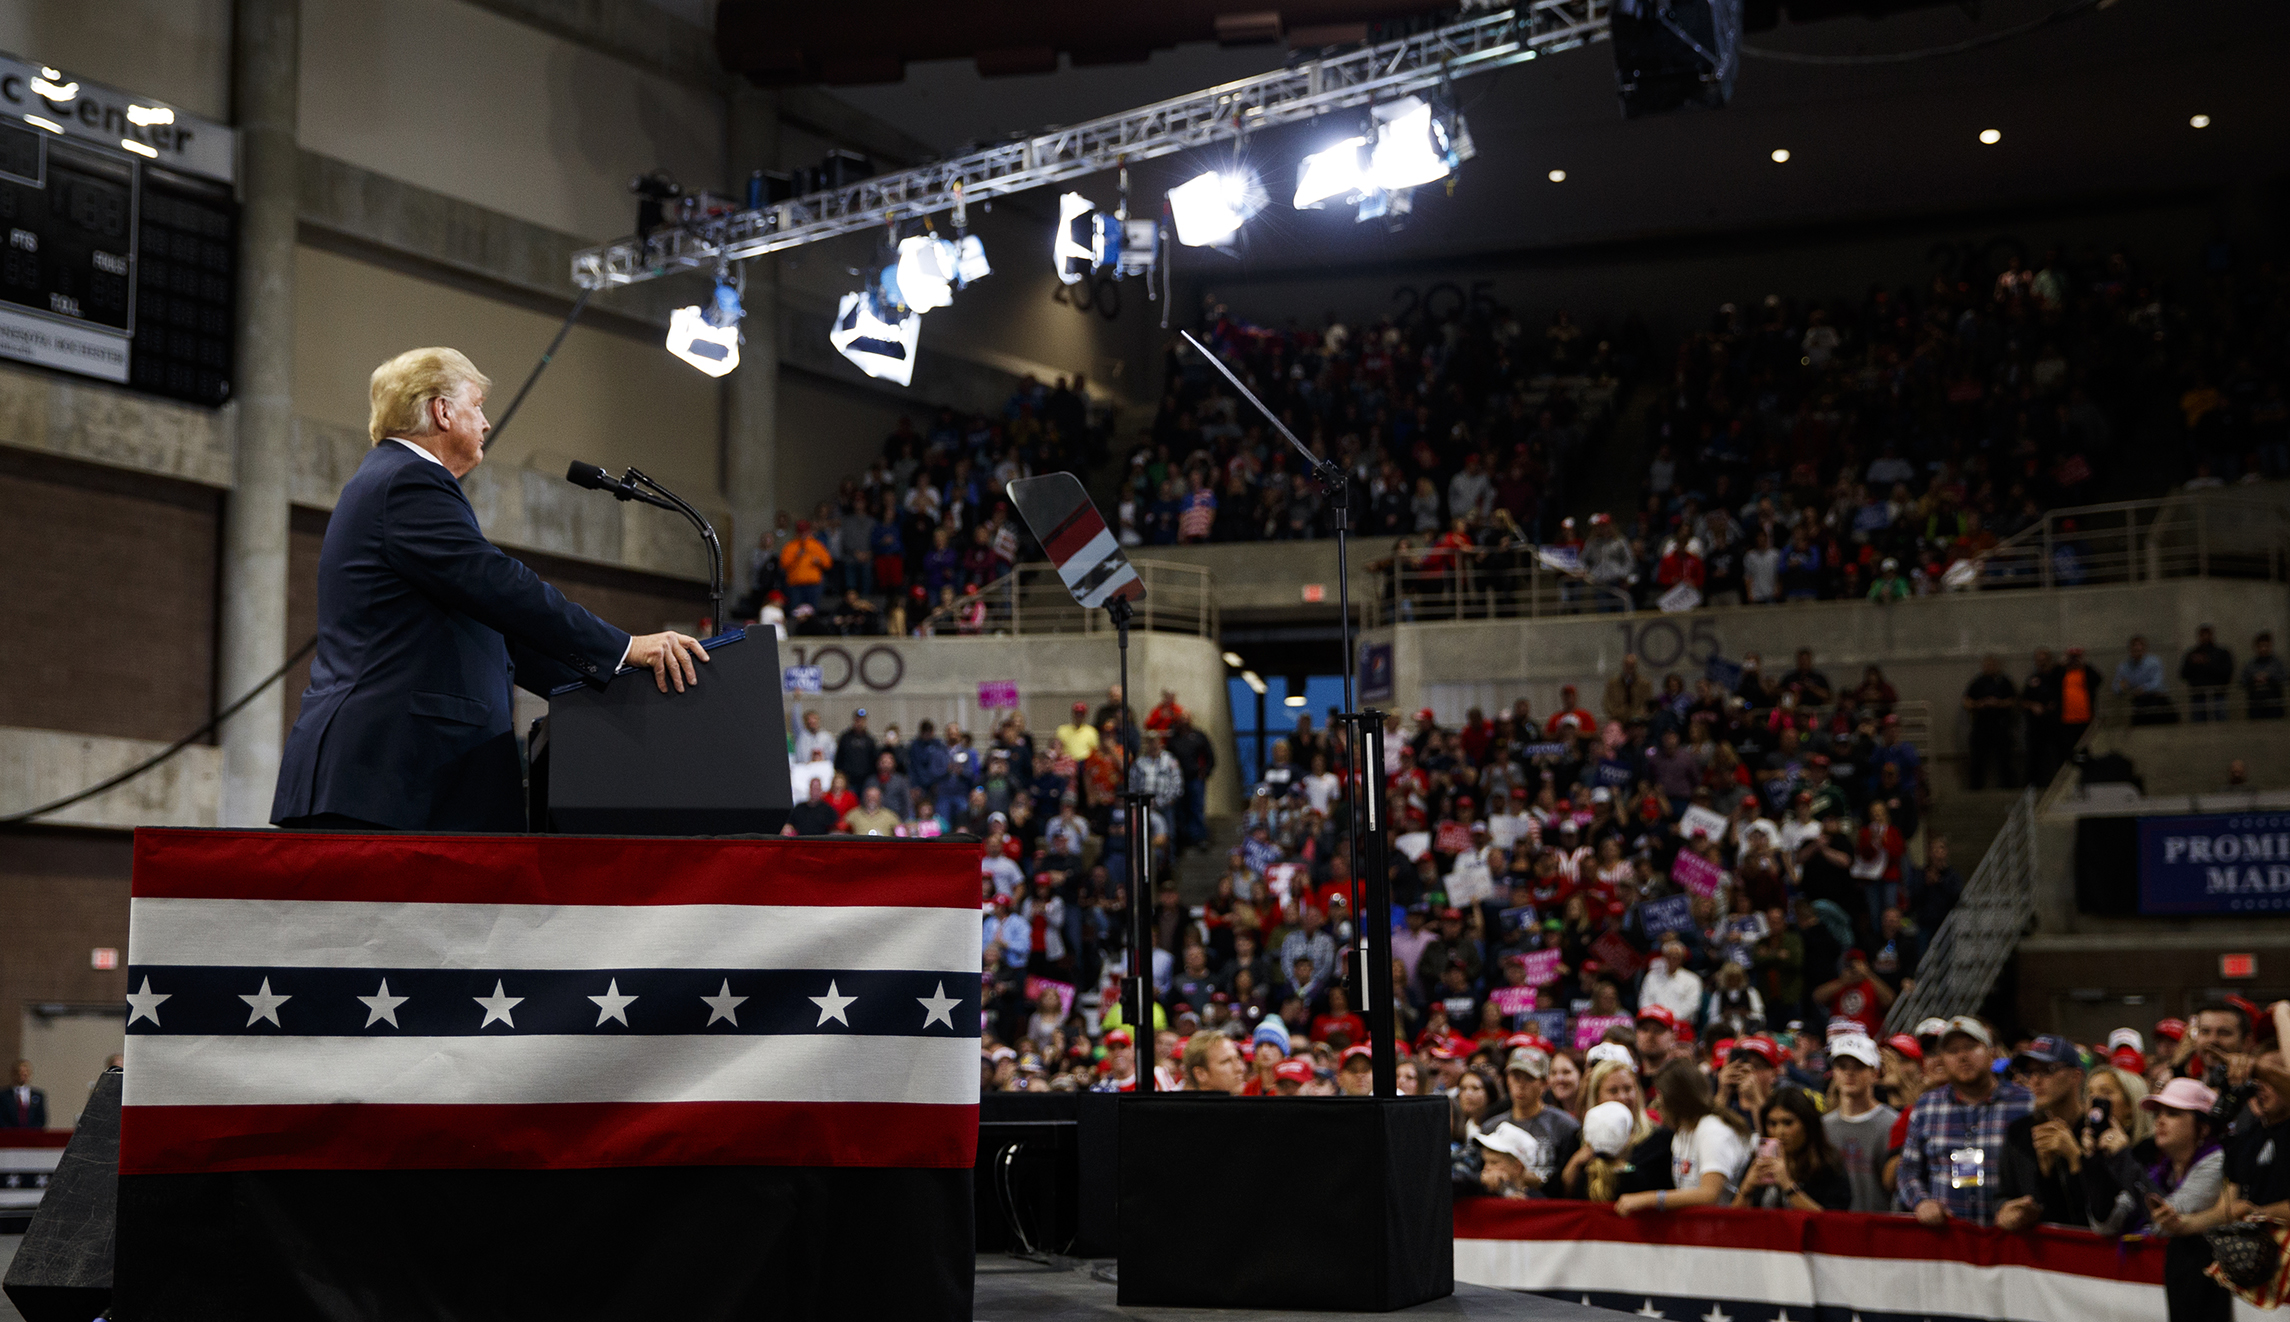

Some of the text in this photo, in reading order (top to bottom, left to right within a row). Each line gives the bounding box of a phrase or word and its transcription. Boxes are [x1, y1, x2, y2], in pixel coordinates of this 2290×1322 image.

[1617, 617, 1719, 668] 105
[2162, 832, 2290, 865] PROMI
[2205, 863, 2290, 895] MAD
